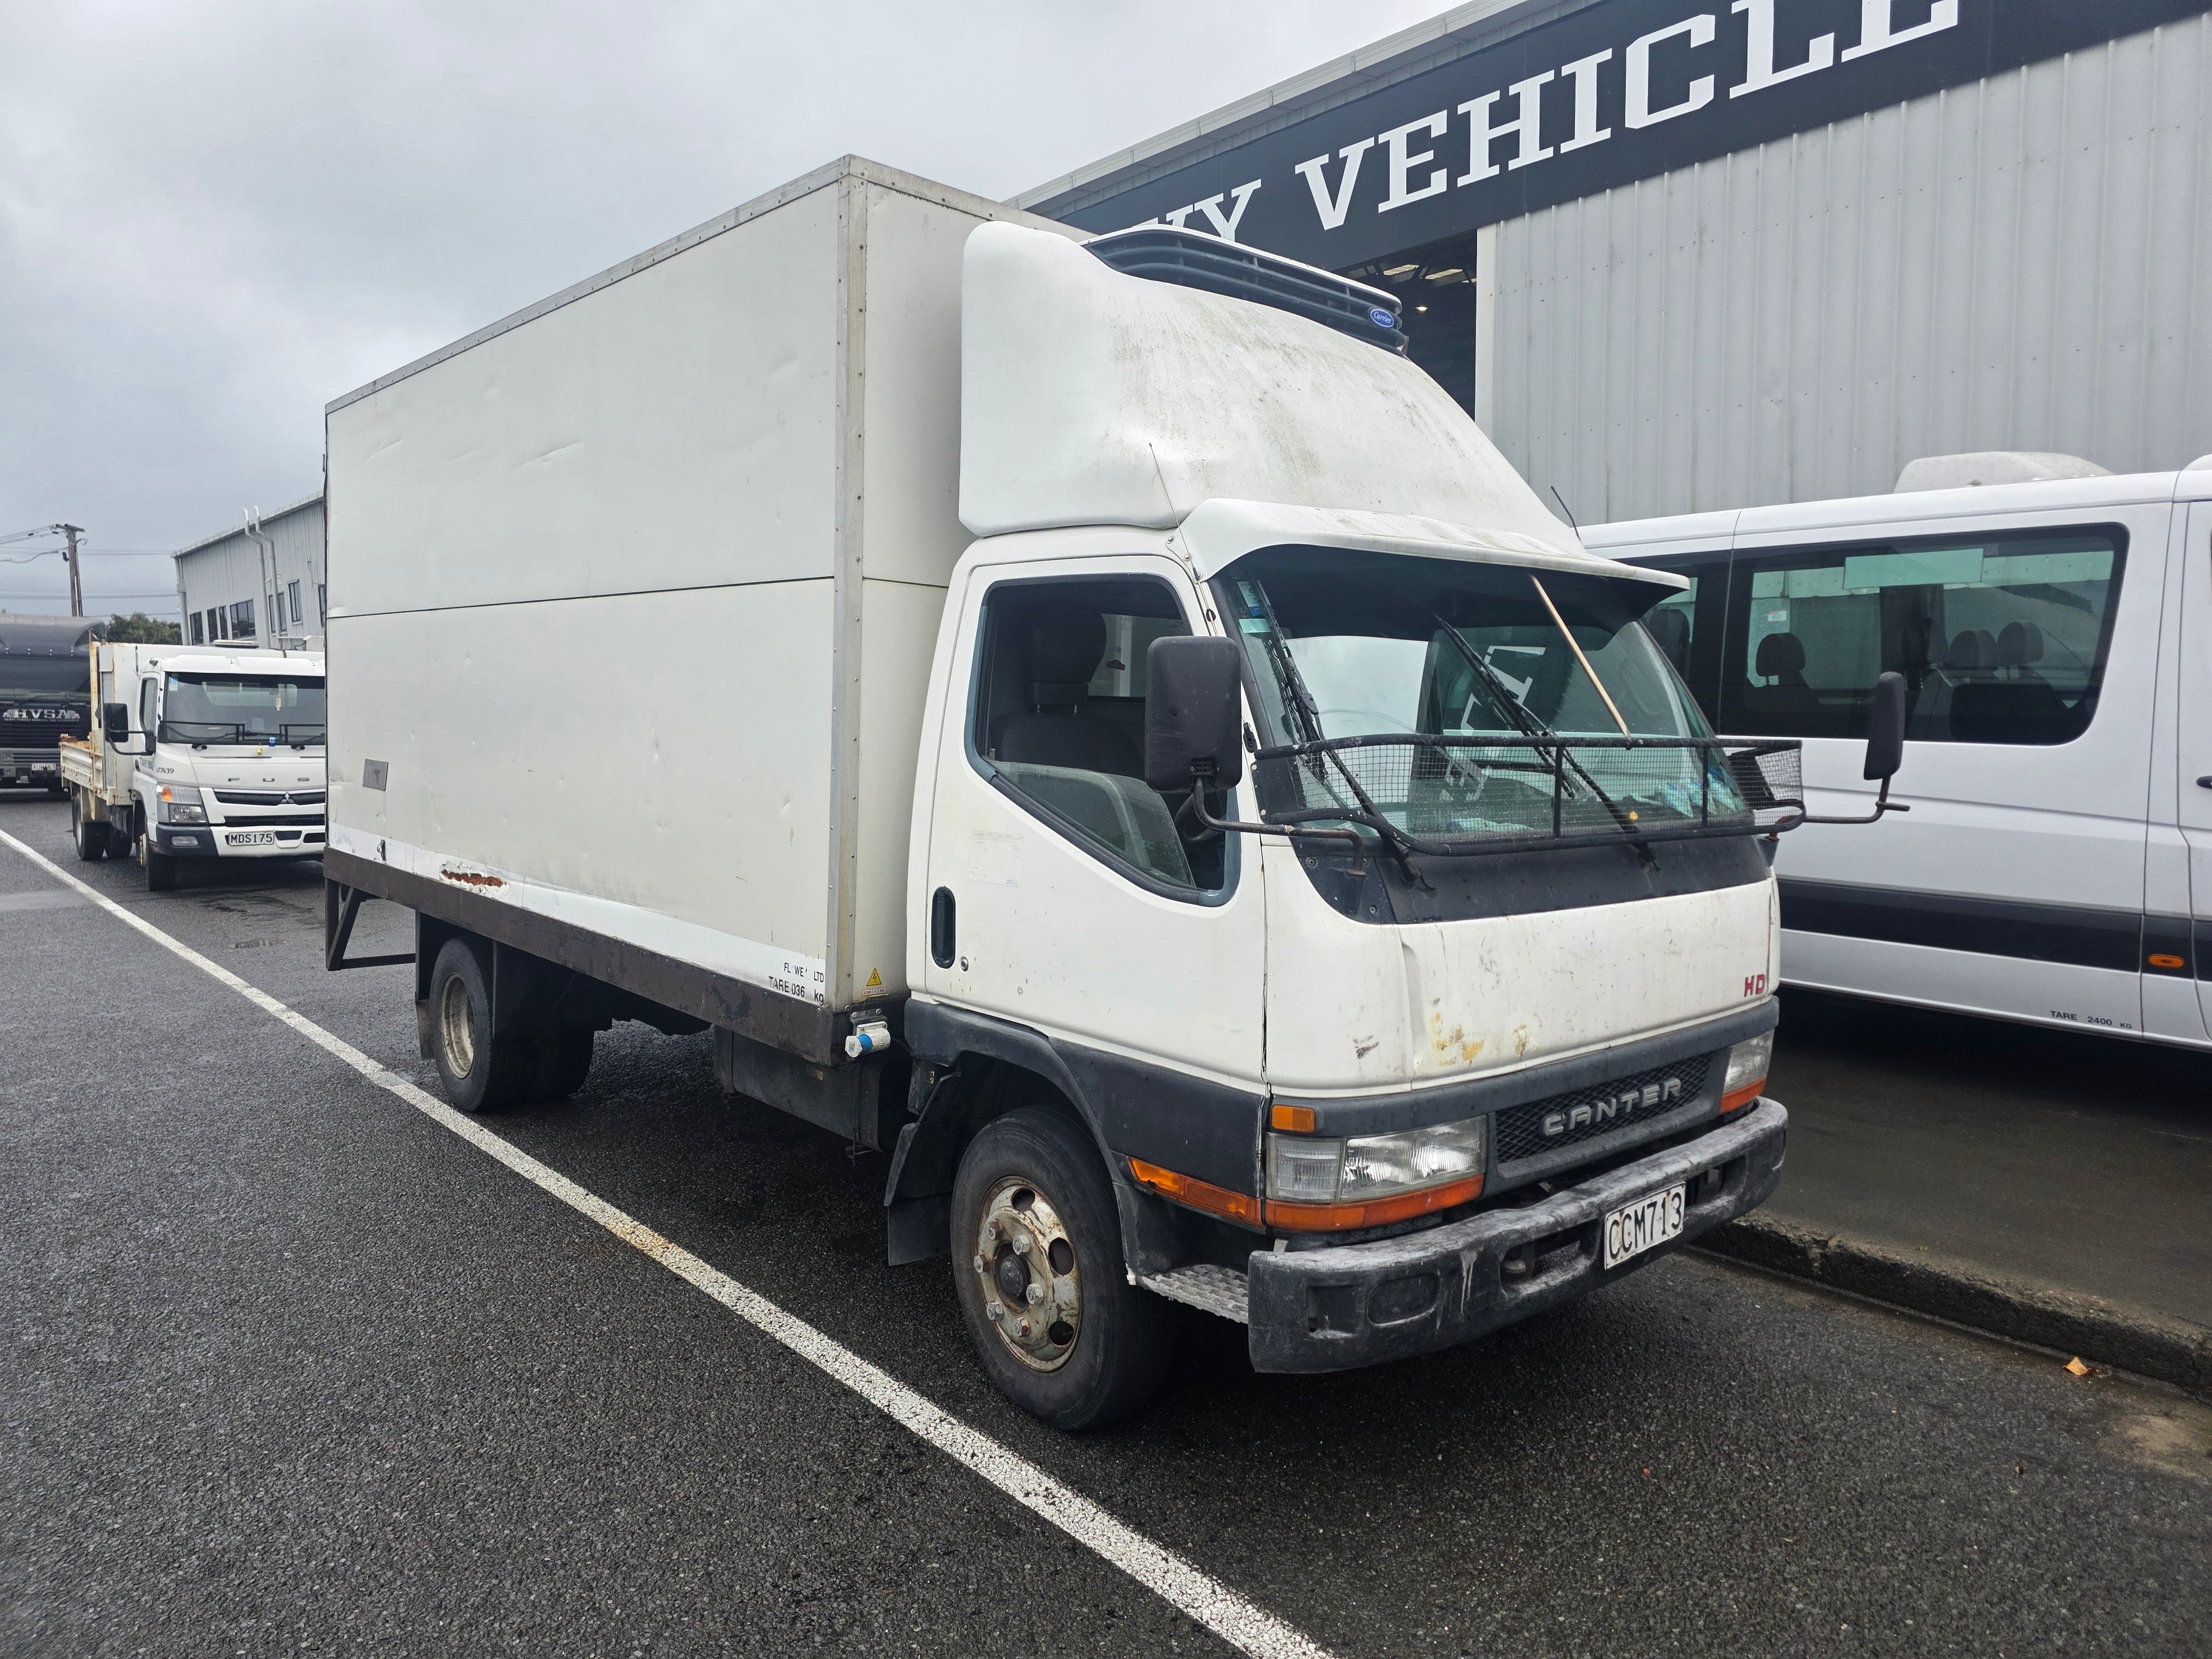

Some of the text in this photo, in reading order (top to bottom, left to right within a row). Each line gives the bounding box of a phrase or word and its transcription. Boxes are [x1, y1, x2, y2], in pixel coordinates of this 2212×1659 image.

[1373, 311, 1392, 324] Carrier
[13, 709, 70, 719] HVSA
[230, 834, 272, 843] MDS175
[814, 971, 824, 983] LTD
[768, 976, 789, 993] TARE
[814, 989, 824, 1006] kg
[1744, 974, 1766, 997] HD
[2050, 1010, 2078, 1021] TARE
[2087, 1016, 2112, 1026] 2400
[1543, 1077, 1681, 1137] CANTER
[1609, 1192, 1682, 1260] CCM713
